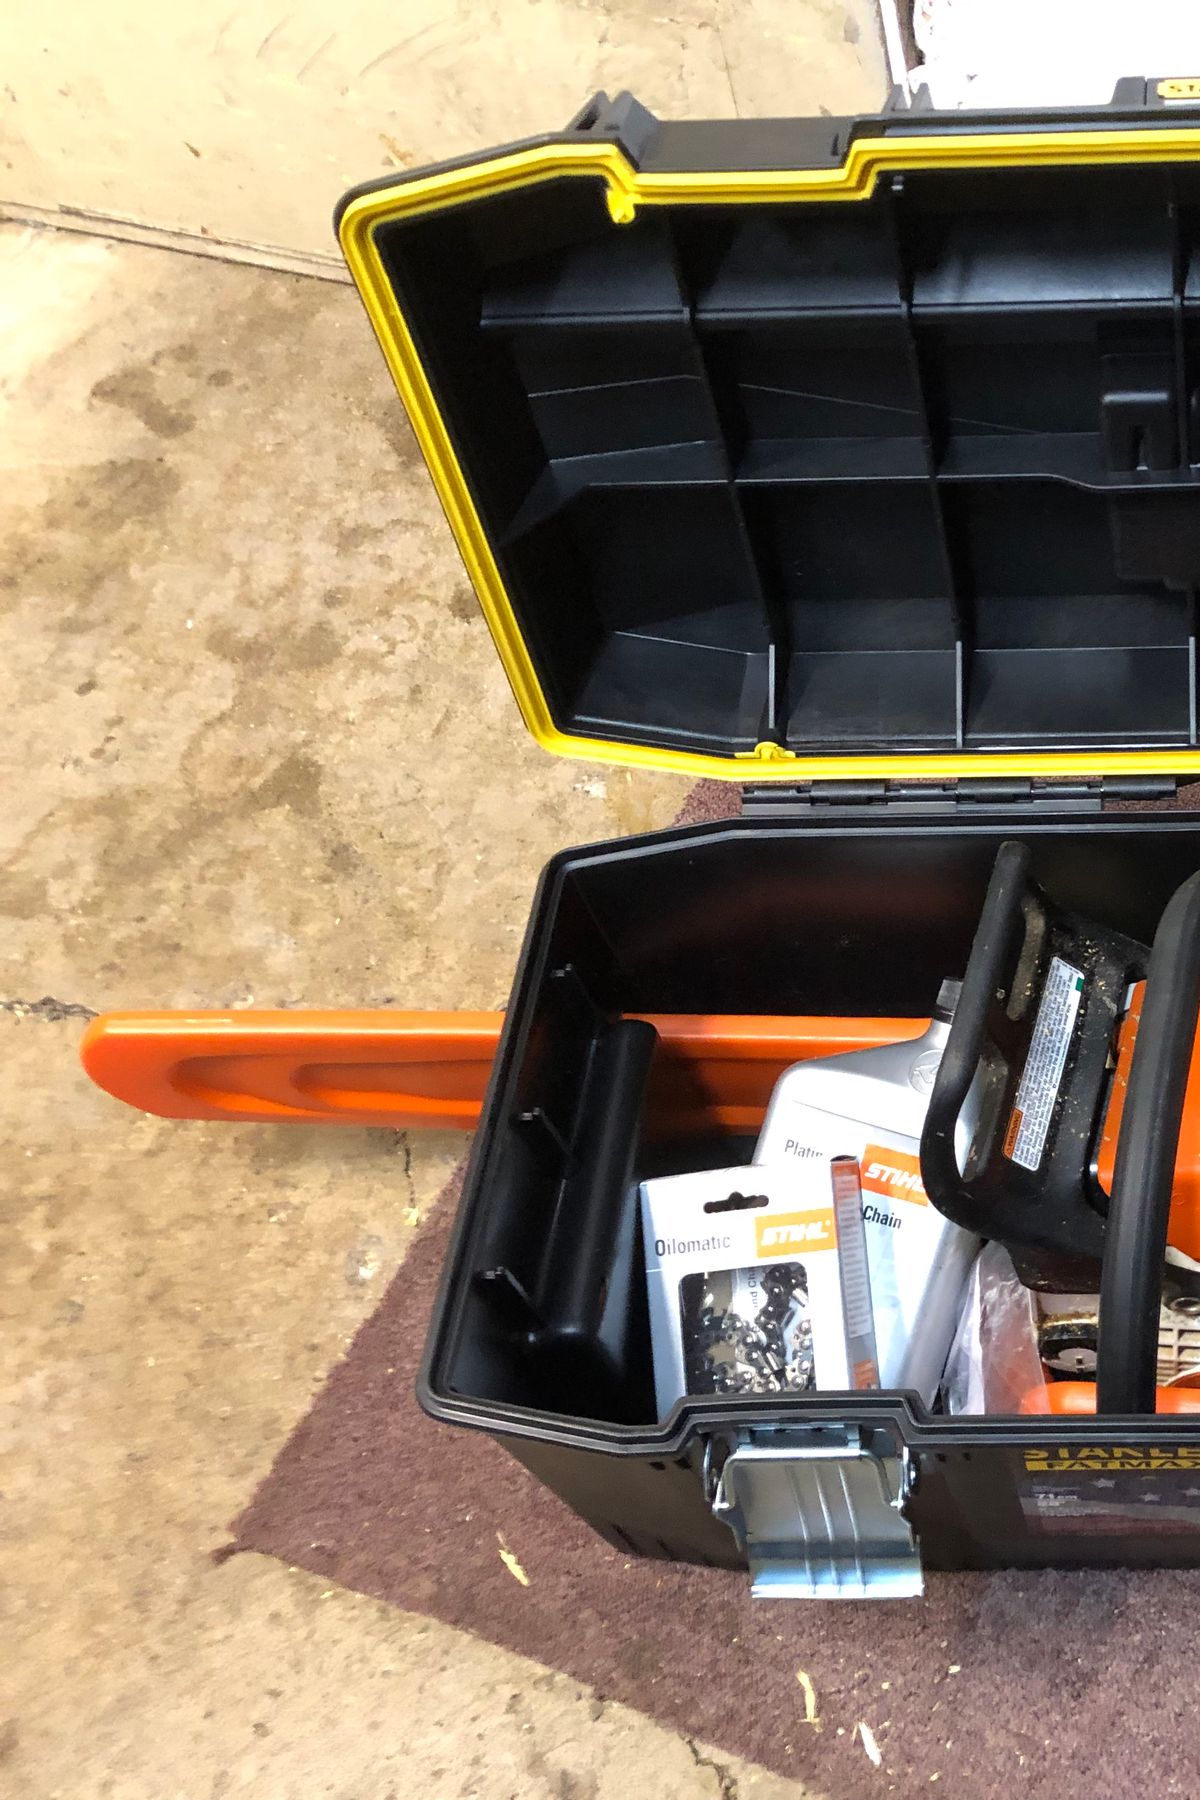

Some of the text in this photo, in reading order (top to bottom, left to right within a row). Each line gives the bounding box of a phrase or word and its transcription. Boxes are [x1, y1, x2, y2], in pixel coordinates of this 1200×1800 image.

[864, 1162, 926, 1193] STIHL
[863, 1205, 902, 1229] Chain
[760, 1220, 830, 1247] STIHL
[654, 1236, 731, 1257] Oilomatic
